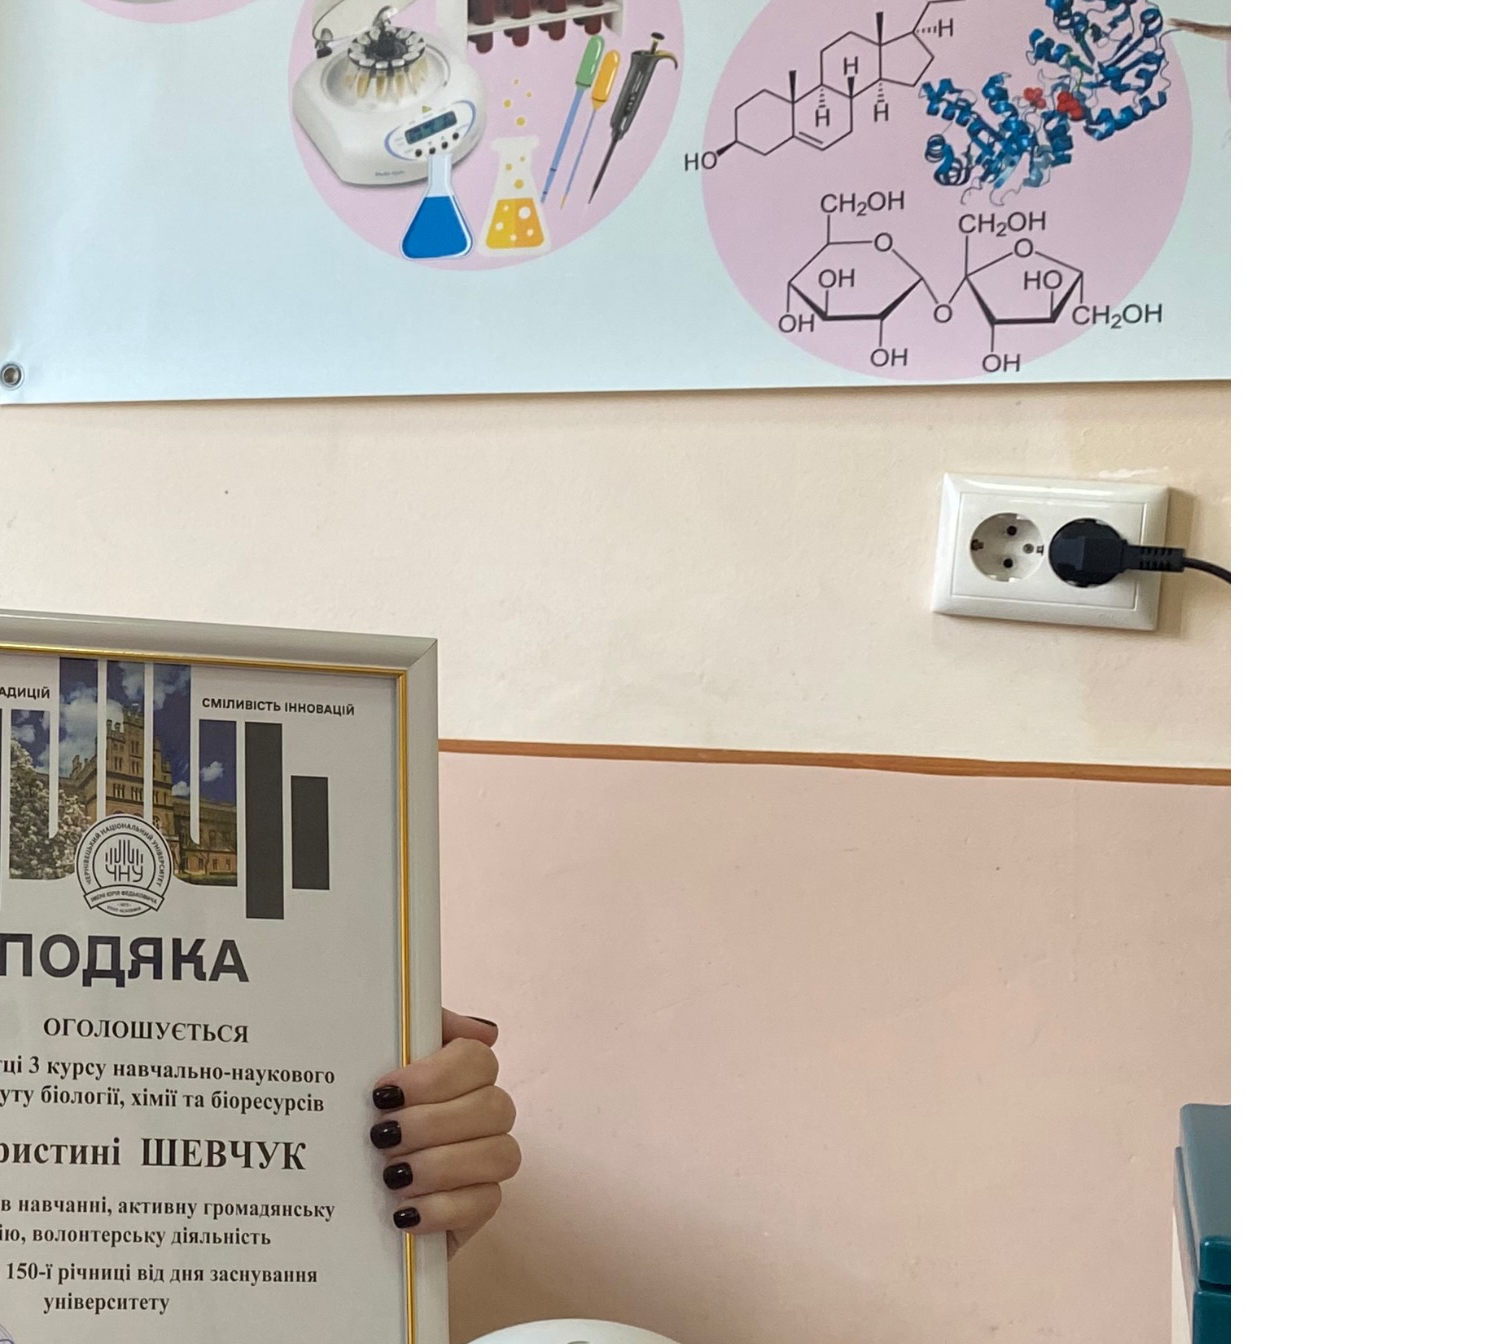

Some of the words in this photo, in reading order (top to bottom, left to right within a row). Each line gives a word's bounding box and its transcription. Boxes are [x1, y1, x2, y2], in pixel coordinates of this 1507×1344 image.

[937, 20, 954, 37] H
[843, 57, 859, 75] H
[815, 109, 831, 127] H
[874, 103, 890, 122] H
[684, 151, 718, 171] HO
[818, 269, 855, 289] OH
[1023, 271, 1063, 290] HO
[778, 314, 815, 334] OH
[870, 348, 908, 368] OH
[982, 353, 1021, 373] OH
[202, 698, 281, 712] СМІЛИВІСТЬ
[285, 702, 355, 716] ІННОВАЦІЙ
[43, 1017, 249, 1043] ОГОЛОШУЄТЬСЯ
[28, 1056, 40, 1074] 3
[47, 1060, 106, 1080] курсу
[113, 1062, 335, 1086] навчально-наукового
[41, 1085, 125, 1109] біології,
[131, 1088, 178, 1107] хімії
[182, 1094, 205, 1108] та
[211, 1091, 324, 1116] біоресурсів
[141, 1137, 306, 1170] ШЕВЧУК
[0, 1199, 11, 1212] в
[18, 1196, 112, 1216] навчанні,
[118, 1200, 197, 1219] активну
[203, 1202, 335, 1222] громадянську
[32, 1227, 166, 1248] волонтерську
[171, 1227, 271, 1245] діяльність
[6, 1262, 53, 1280] 150-ї
[57, 1263, 131, 1285] річниці
[137, 1264, 164, 1283] від
[169, 1268, 204, 1283] дня
[210, 1268, 318, 1287] заснування
[43, 1293, 170, 1315] університету
